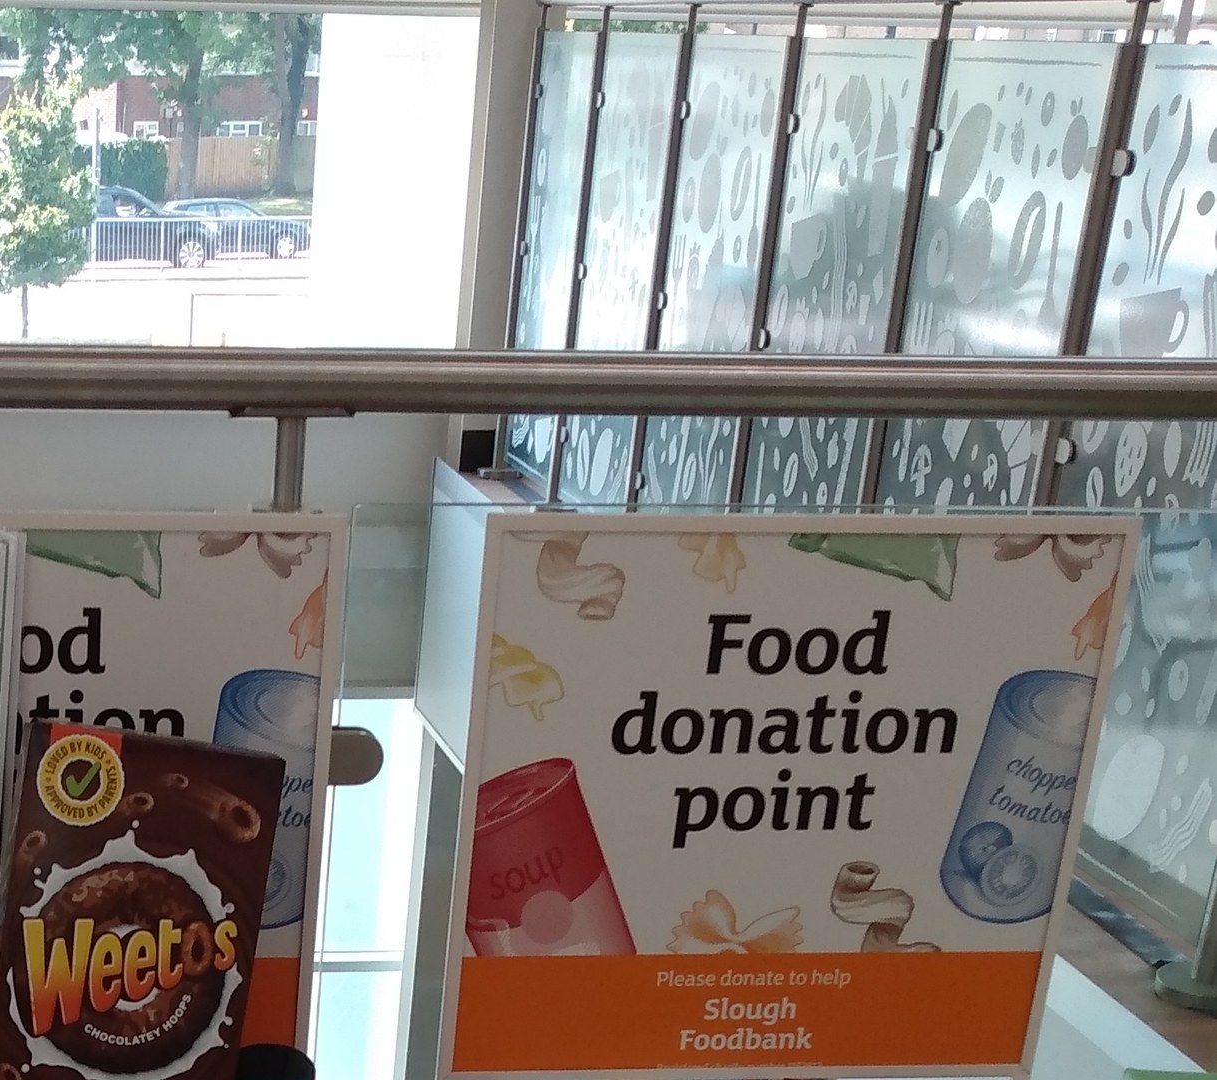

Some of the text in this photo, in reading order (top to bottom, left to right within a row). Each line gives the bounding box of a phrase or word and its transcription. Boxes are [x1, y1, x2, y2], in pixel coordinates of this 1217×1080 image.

[20, 607, 106, 675] od
[704, 608, 890, 676] Food
[610, 690, 958, 755] donation
[45, 741, 107, 775] LOVED BY KIDS
[1005, 755, 1076, 792] choppe
[45, 766, 118, 819] APPROVED BY PARENTS
[670, 768, 878, 849] point
[988, 784, 1072, 826] tomatoe
[487, 842, 567, 900] soup
[22, 917, 239, 1037] Weetos
[656, 969, 852, 989] Please donate to help
[84, 992, 193, 1047] CHOCOLATEY HOOPS
[703, 996, 797, 1027] Slough
[679, 1027, 814, 1051] Foodbank
